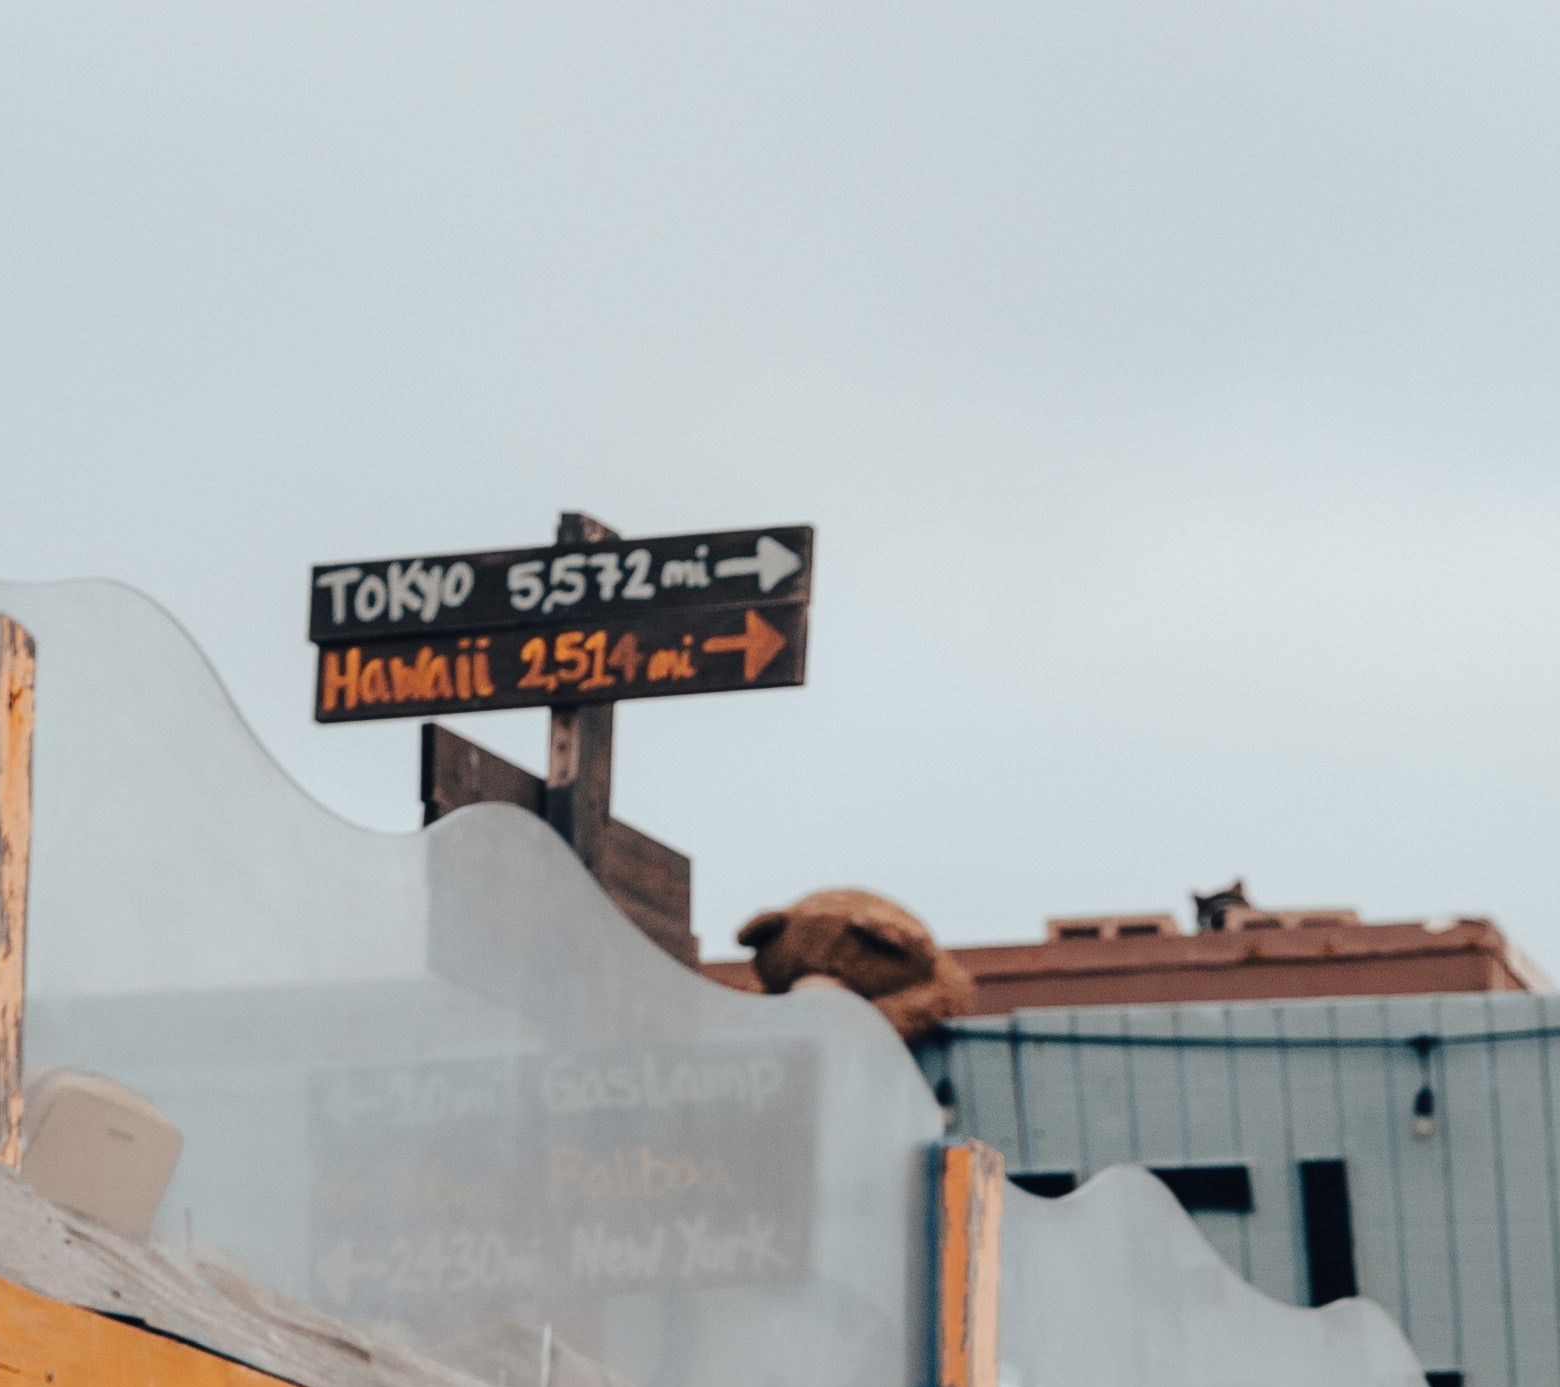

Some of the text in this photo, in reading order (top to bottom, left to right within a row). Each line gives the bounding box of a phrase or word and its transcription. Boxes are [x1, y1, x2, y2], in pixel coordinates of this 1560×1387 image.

[507, 547, 656, 614] 5,572
[661, 544, 711, 588] mi
[322, 629, 698, 713] Hawaii 2,514 mi
[571, 1221, 666, 1283] New
[674, 1212, 789, 1278] York
